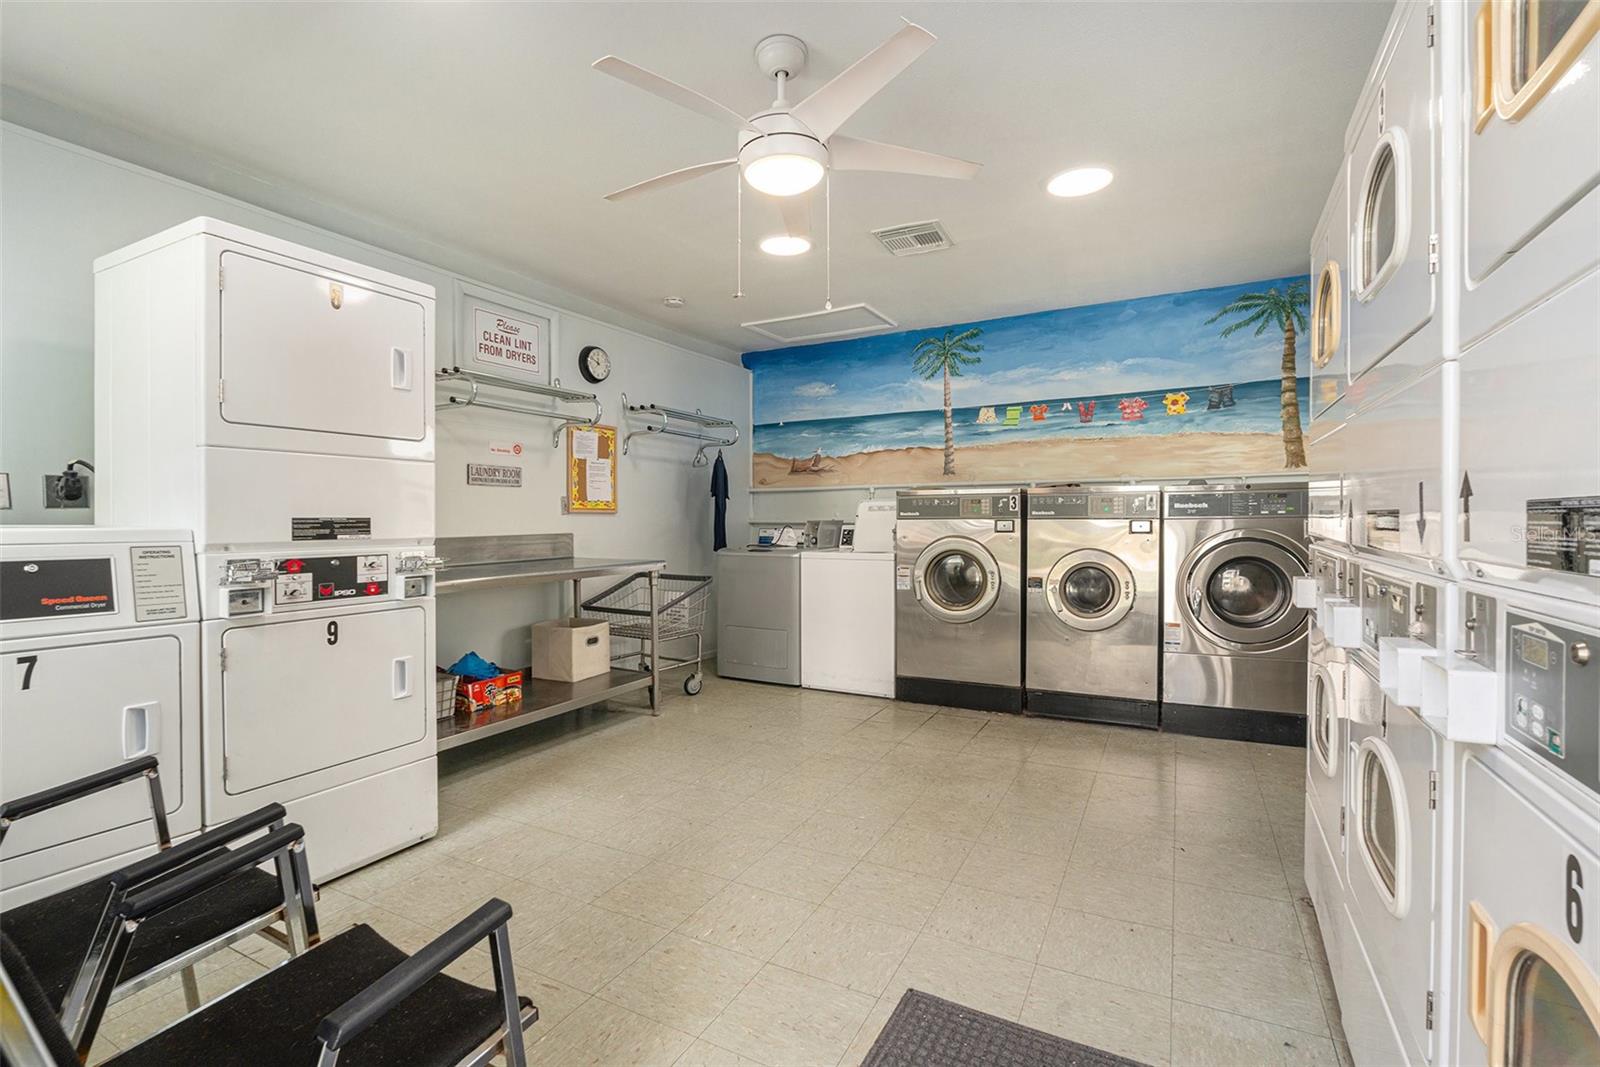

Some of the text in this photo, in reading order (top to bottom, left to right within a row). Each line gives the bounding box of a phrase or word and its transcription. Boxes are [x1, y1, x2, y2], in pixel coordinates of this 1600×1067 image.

[496, 318, 520, 334] Please
[482, 330, 532, 352] CLEAN LINT
[478, 342, 537, 366] FROM DRYERS
[470, 466, 521, 479] LAUNDRY ROOM
[1010, 496, 1018, 510] 3
[55, 602, 107, 611] Commercial Dryer
[326, 620, 339, 646] 9
[16, 655, 38, 690] 7
[1565, 853, 1584, 945] 6
